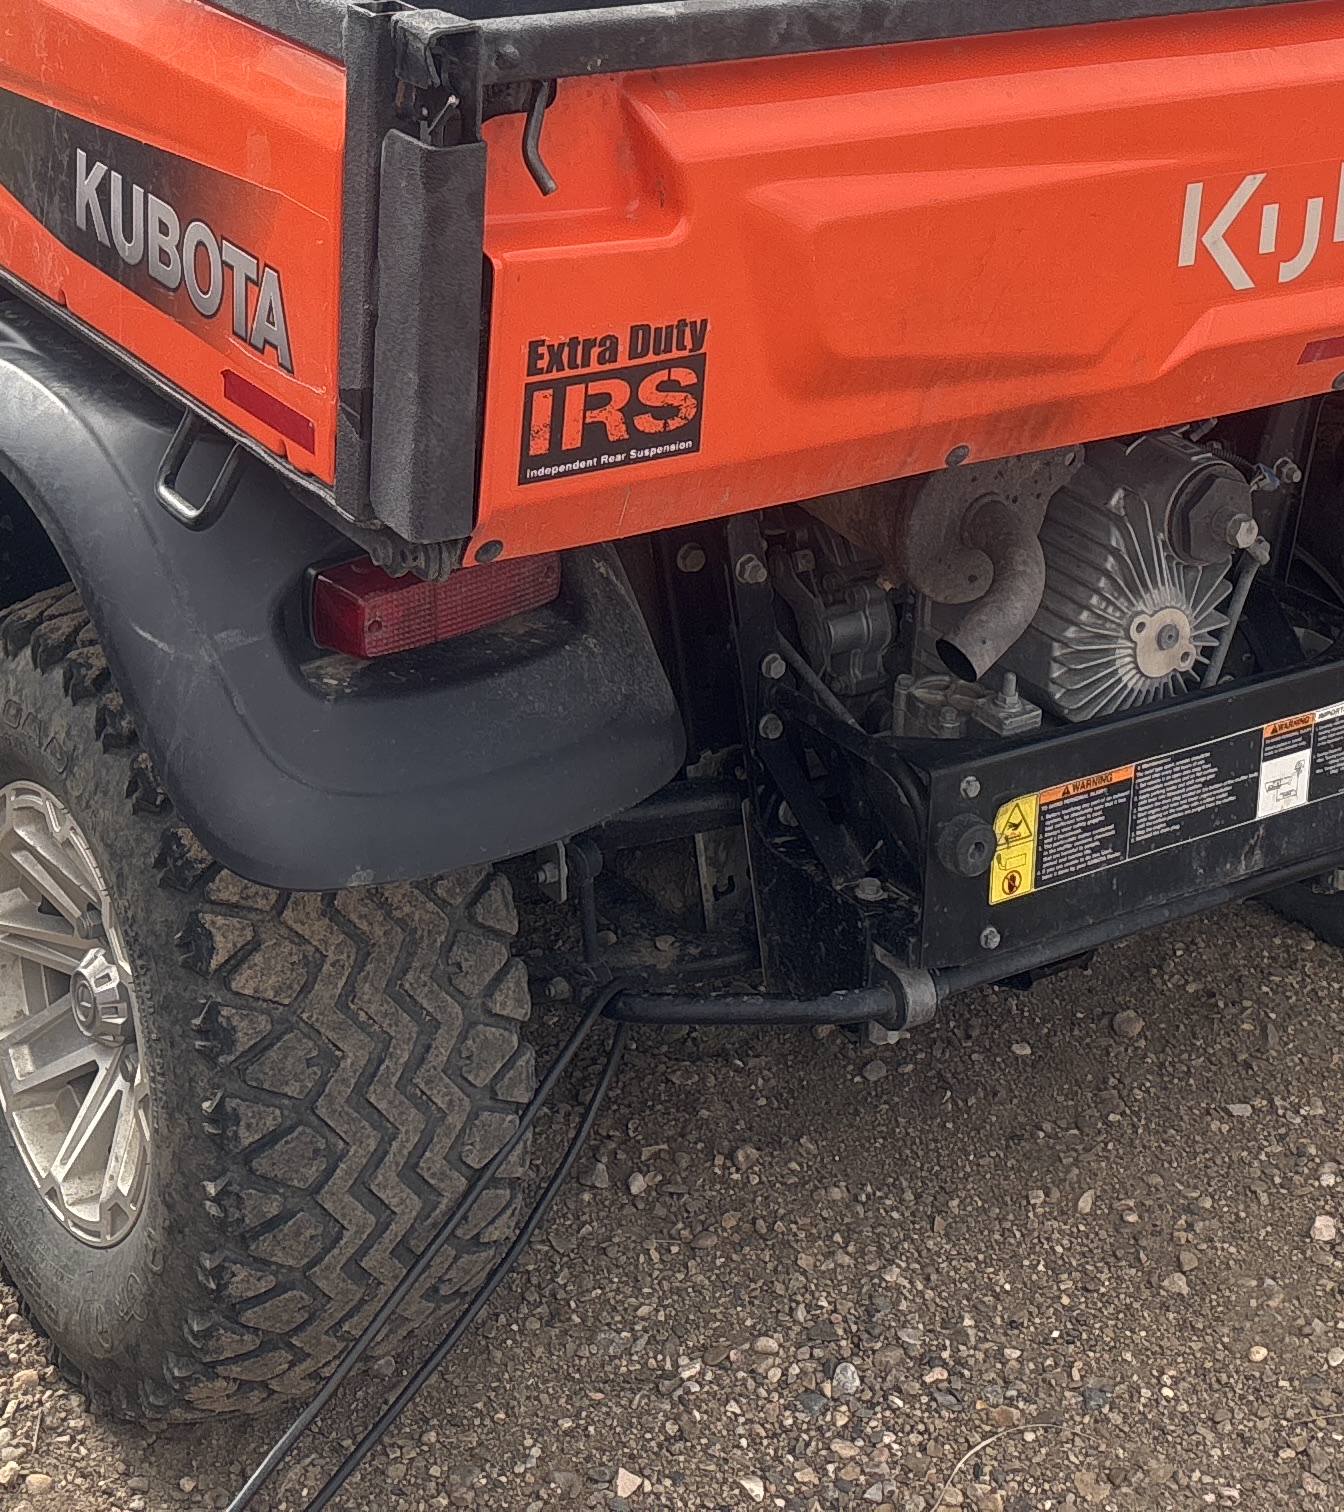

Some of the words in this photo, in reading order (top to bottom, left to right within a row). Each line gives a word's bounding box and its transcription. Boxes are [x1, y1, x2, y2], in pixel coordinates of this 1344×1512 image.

[75, 146, 296, 376] KUBOTA
[526, 334, 619, 377] Extra
[627, 318, 709, 361] Duty
[528, 366, 699, 456] IRS
[526, 456, 598, 479] Independent
[600, 451, 627, 465] Rear
[629, 439, 694, 459] Suspension
[1072, 774, 1113, 793] WARNING
